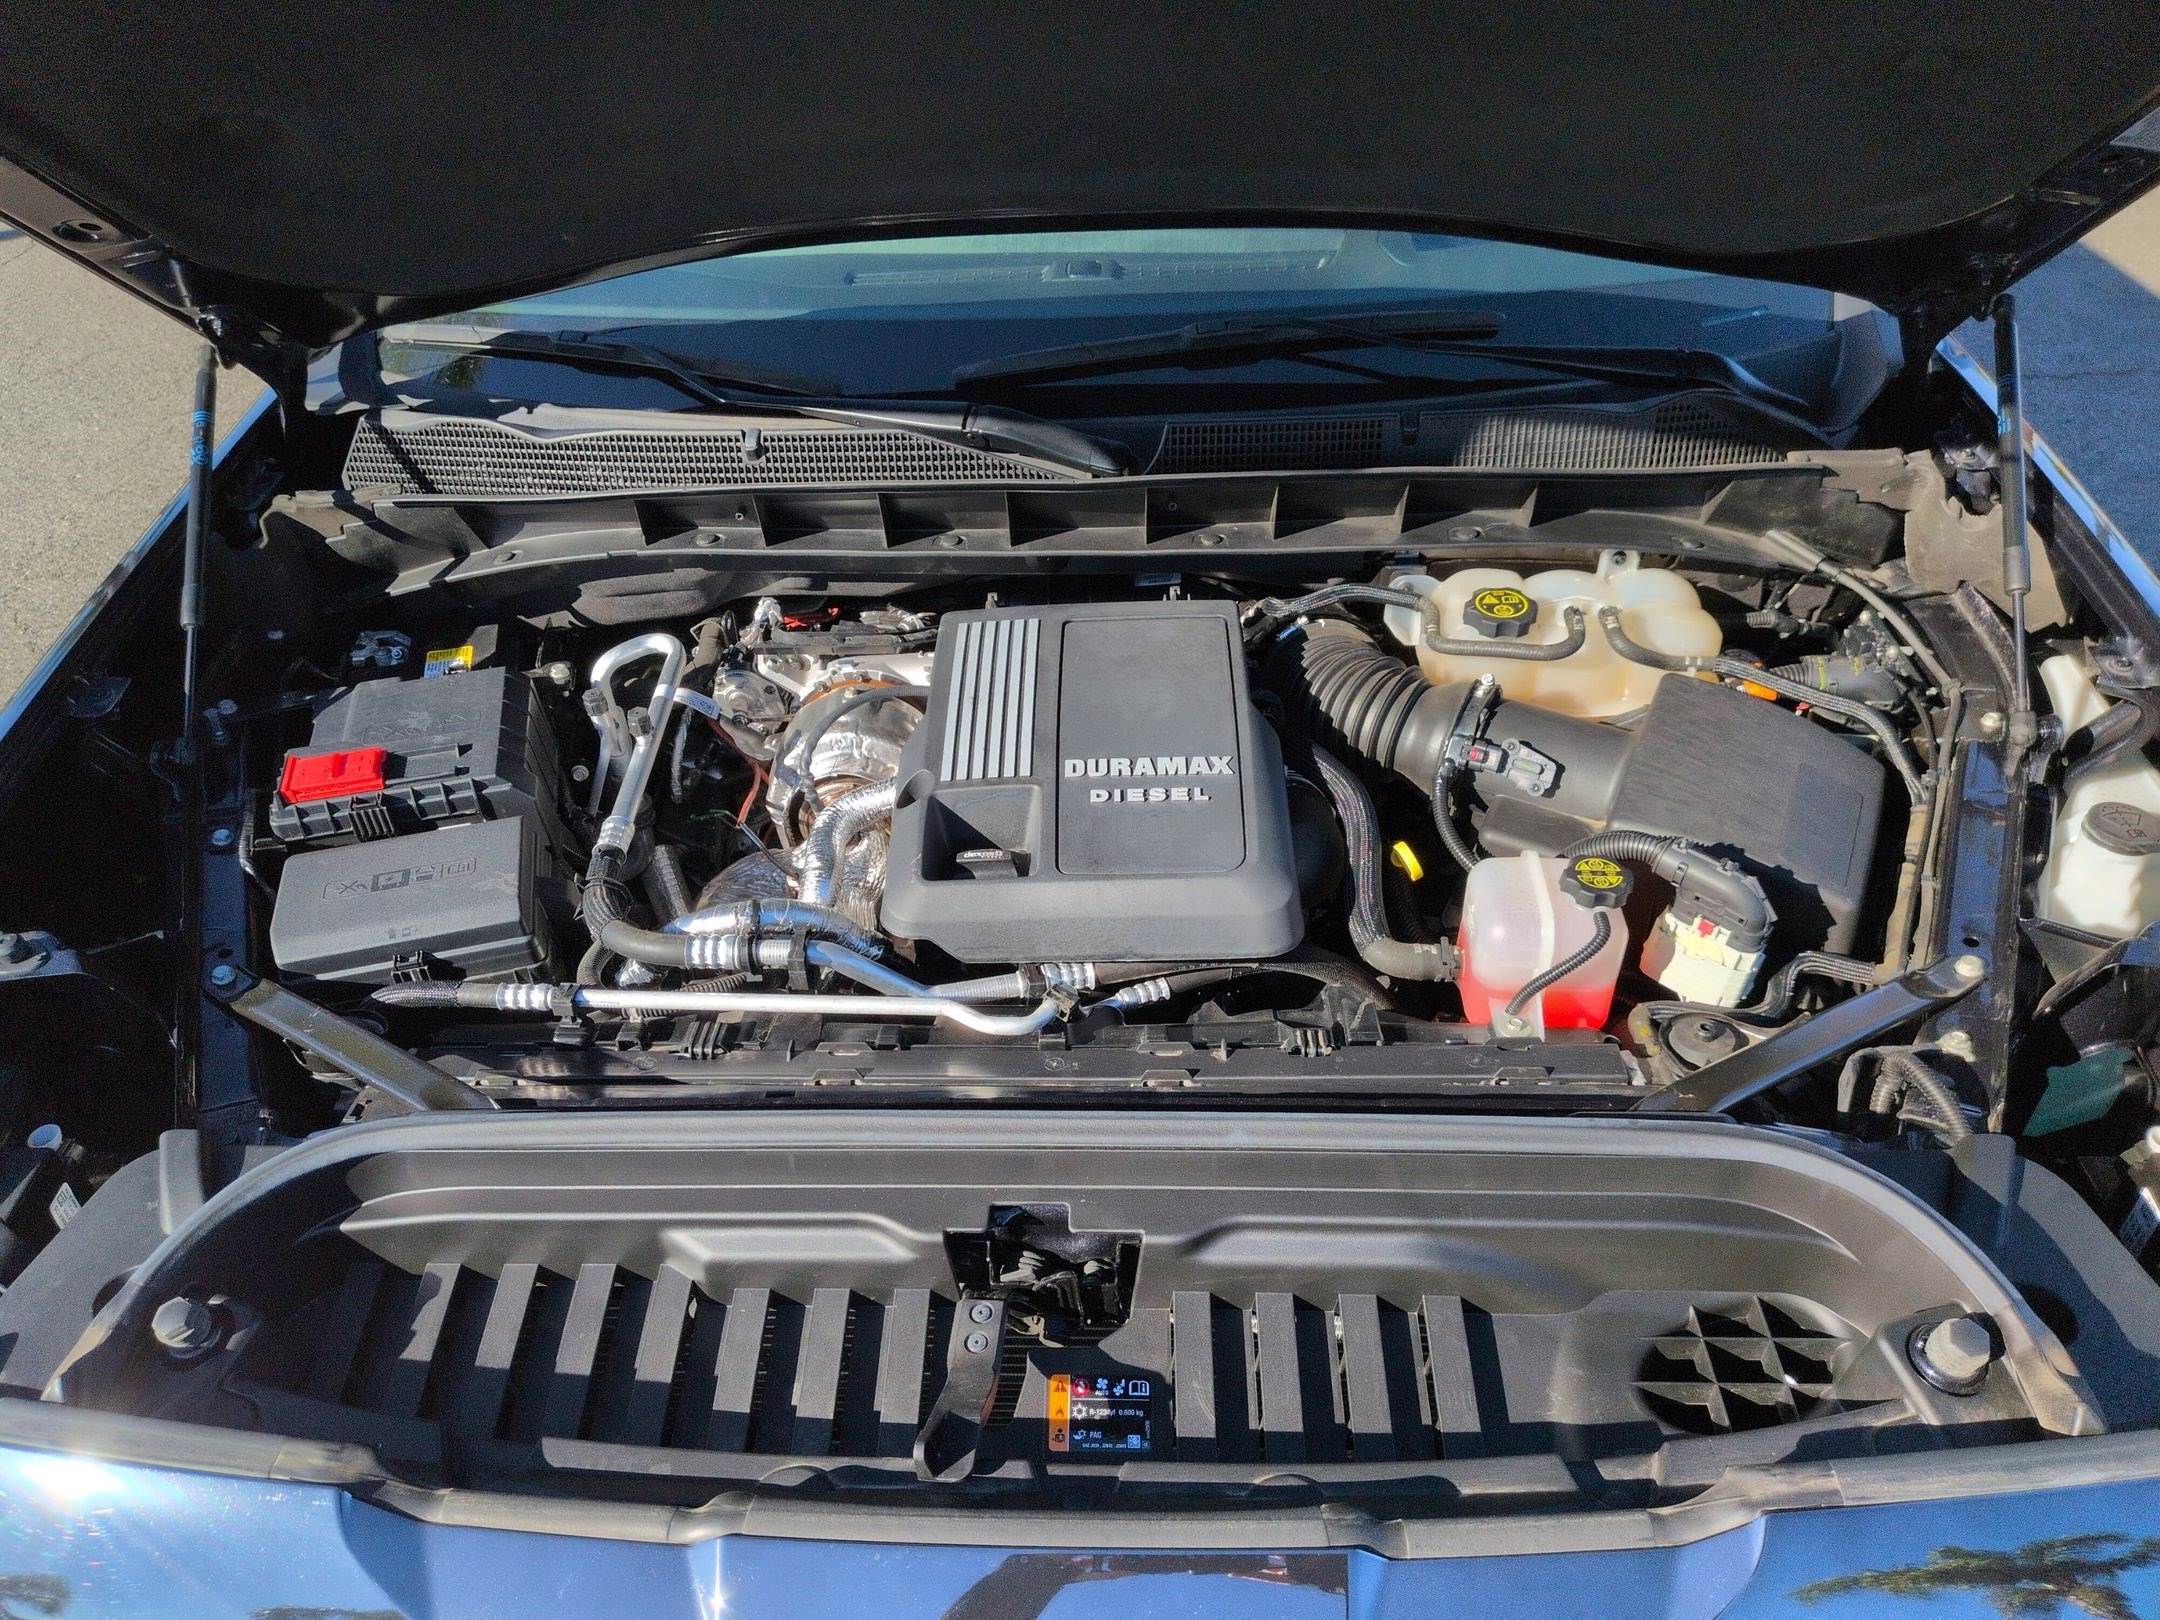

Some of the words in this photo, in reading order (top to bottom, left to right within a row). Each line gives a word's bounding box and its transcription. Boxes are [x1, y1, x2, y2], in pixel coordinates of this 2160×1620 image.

[1064, 755, 1235, 778] DURAMAX
[1089, 787, 1212, 803] DIESEL
[1136, 1409, 1144, 1418] kg
[1089, 1431, 1102, 1439] PAG
